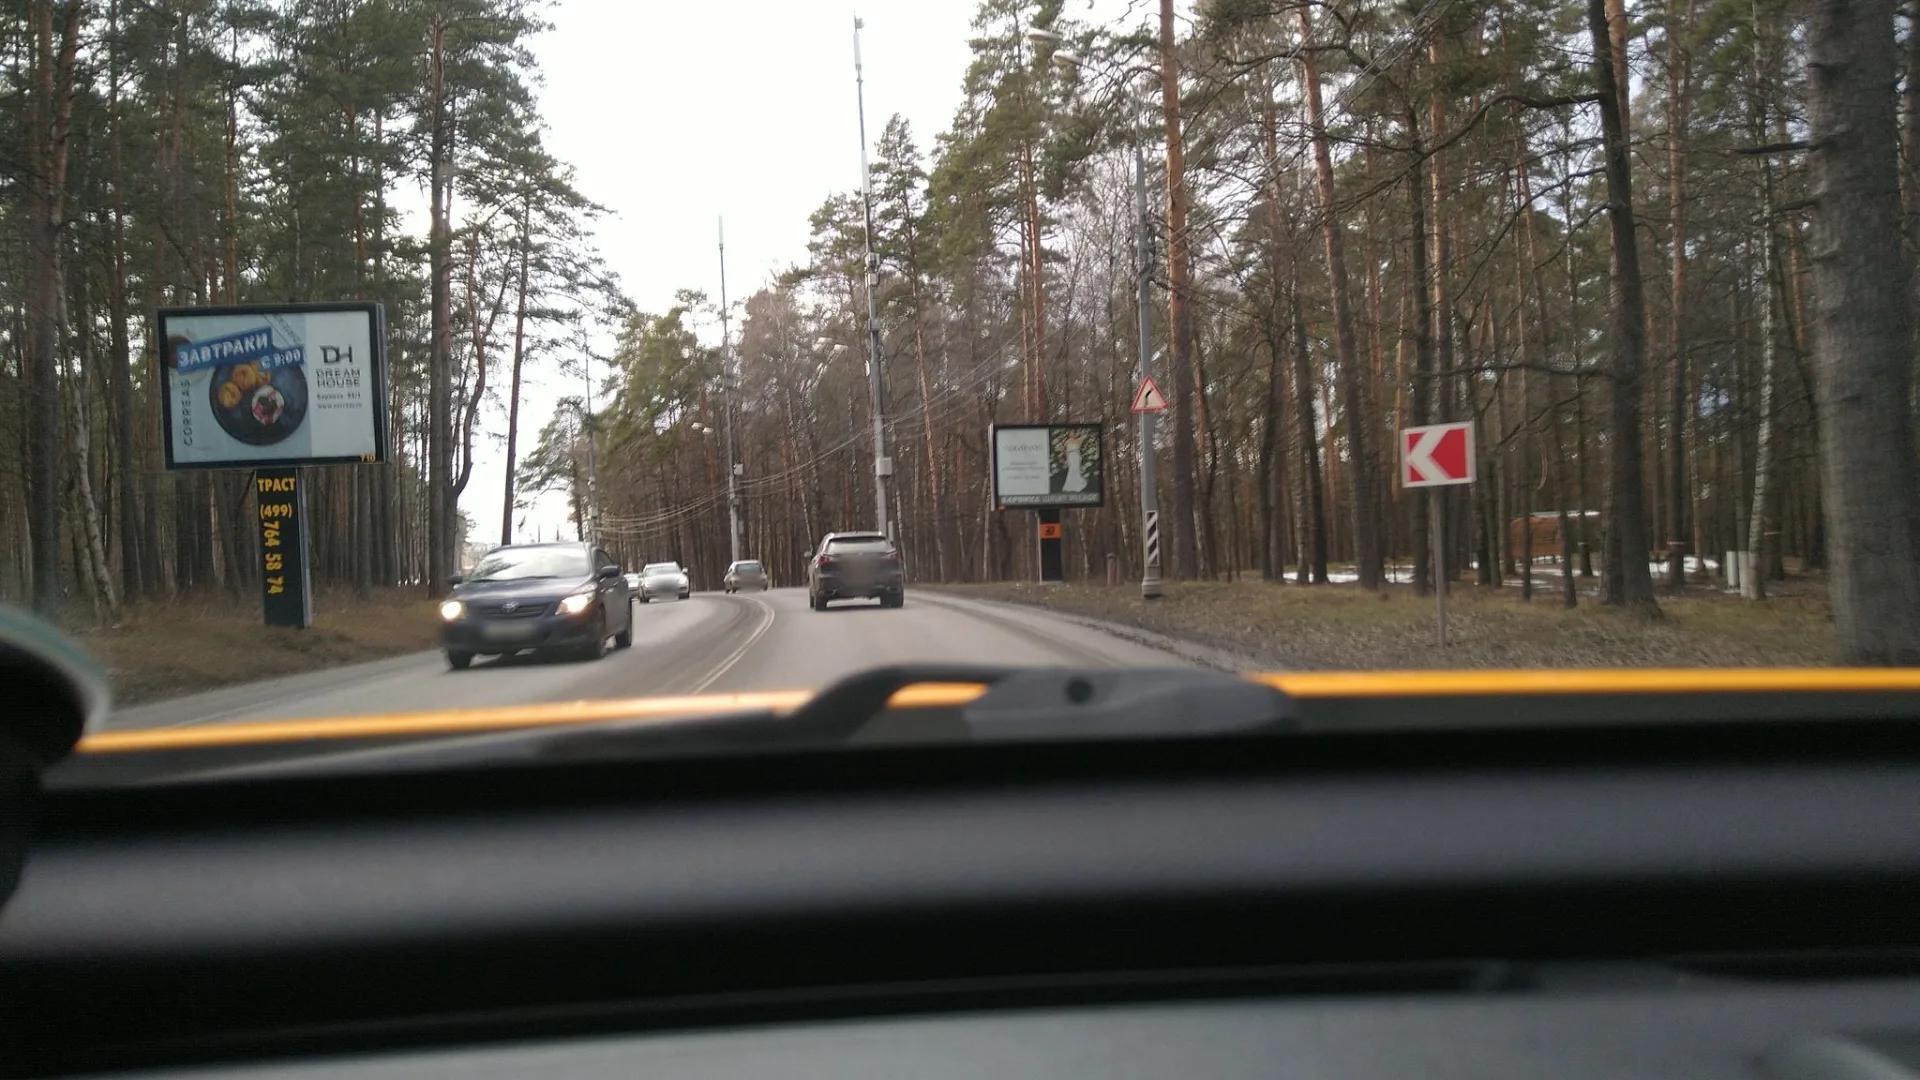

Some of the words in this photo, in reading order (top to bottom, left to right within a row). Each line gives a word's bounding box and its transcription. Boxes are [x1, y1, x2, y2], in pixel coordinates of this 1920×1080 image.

[178, 333, 268, 367] ЗАВТРАКИ
[273, 350, 302, 366] 9:00
[316, 369, 361, 379] DREAM
[317, 379, 361, 389] HOUSE
[258, 478, 295, 492] ТРАСТ
[260, 503, 293, 519] (499)
[263, 520, 281, 547] 764
[265, 553, 282, 571] 58
[267, 576, 284, 594] 74
